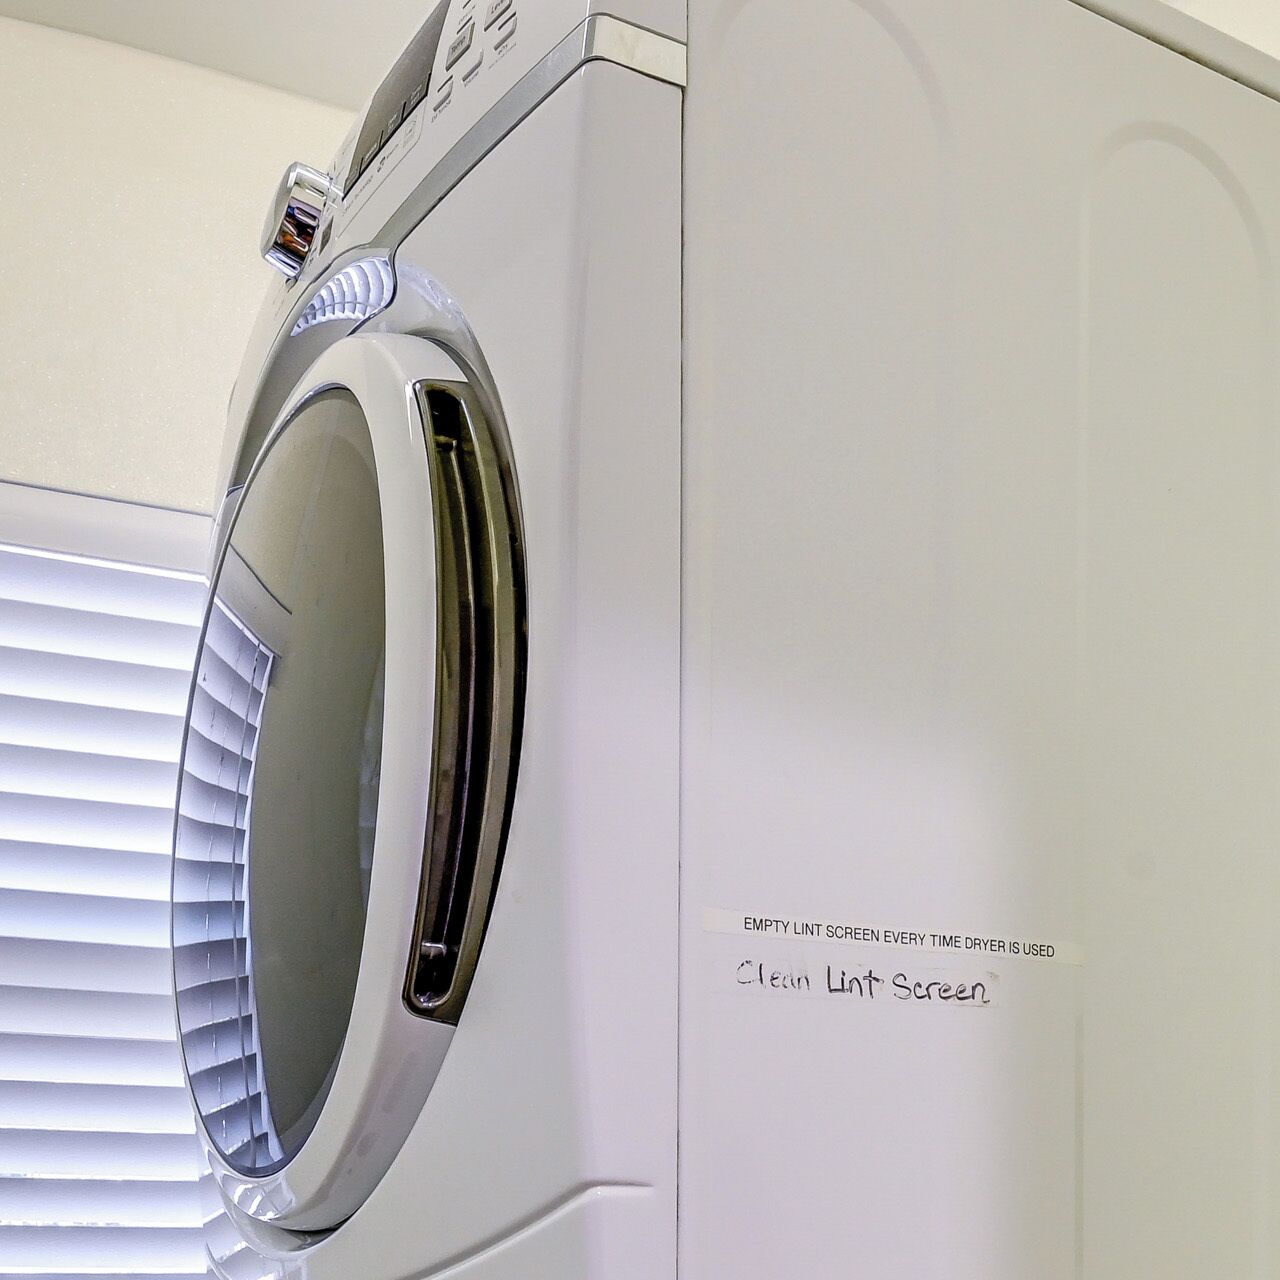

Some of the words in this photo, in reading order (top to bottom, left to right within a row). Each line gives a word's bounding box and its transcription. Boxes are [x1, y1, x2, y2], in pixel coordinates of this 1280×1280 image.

[743, 916, 790, 934] EMPTY
[793, 921, 823, 937] LINT
[825, 924, 880, 943] SCREEN
[883, 930, 927, 946] EVERY
[929, 934, 962, 949] TIME
[965, 937, 1006, 954] DRYER
[1009, 941, 1021, 955] IS
[1022, 943, 1056, 958] USED
[736, 960, 811, 992] Clean
[826, 965, 884, 999] Lint
[892, 972, 991, 1005] Screen
